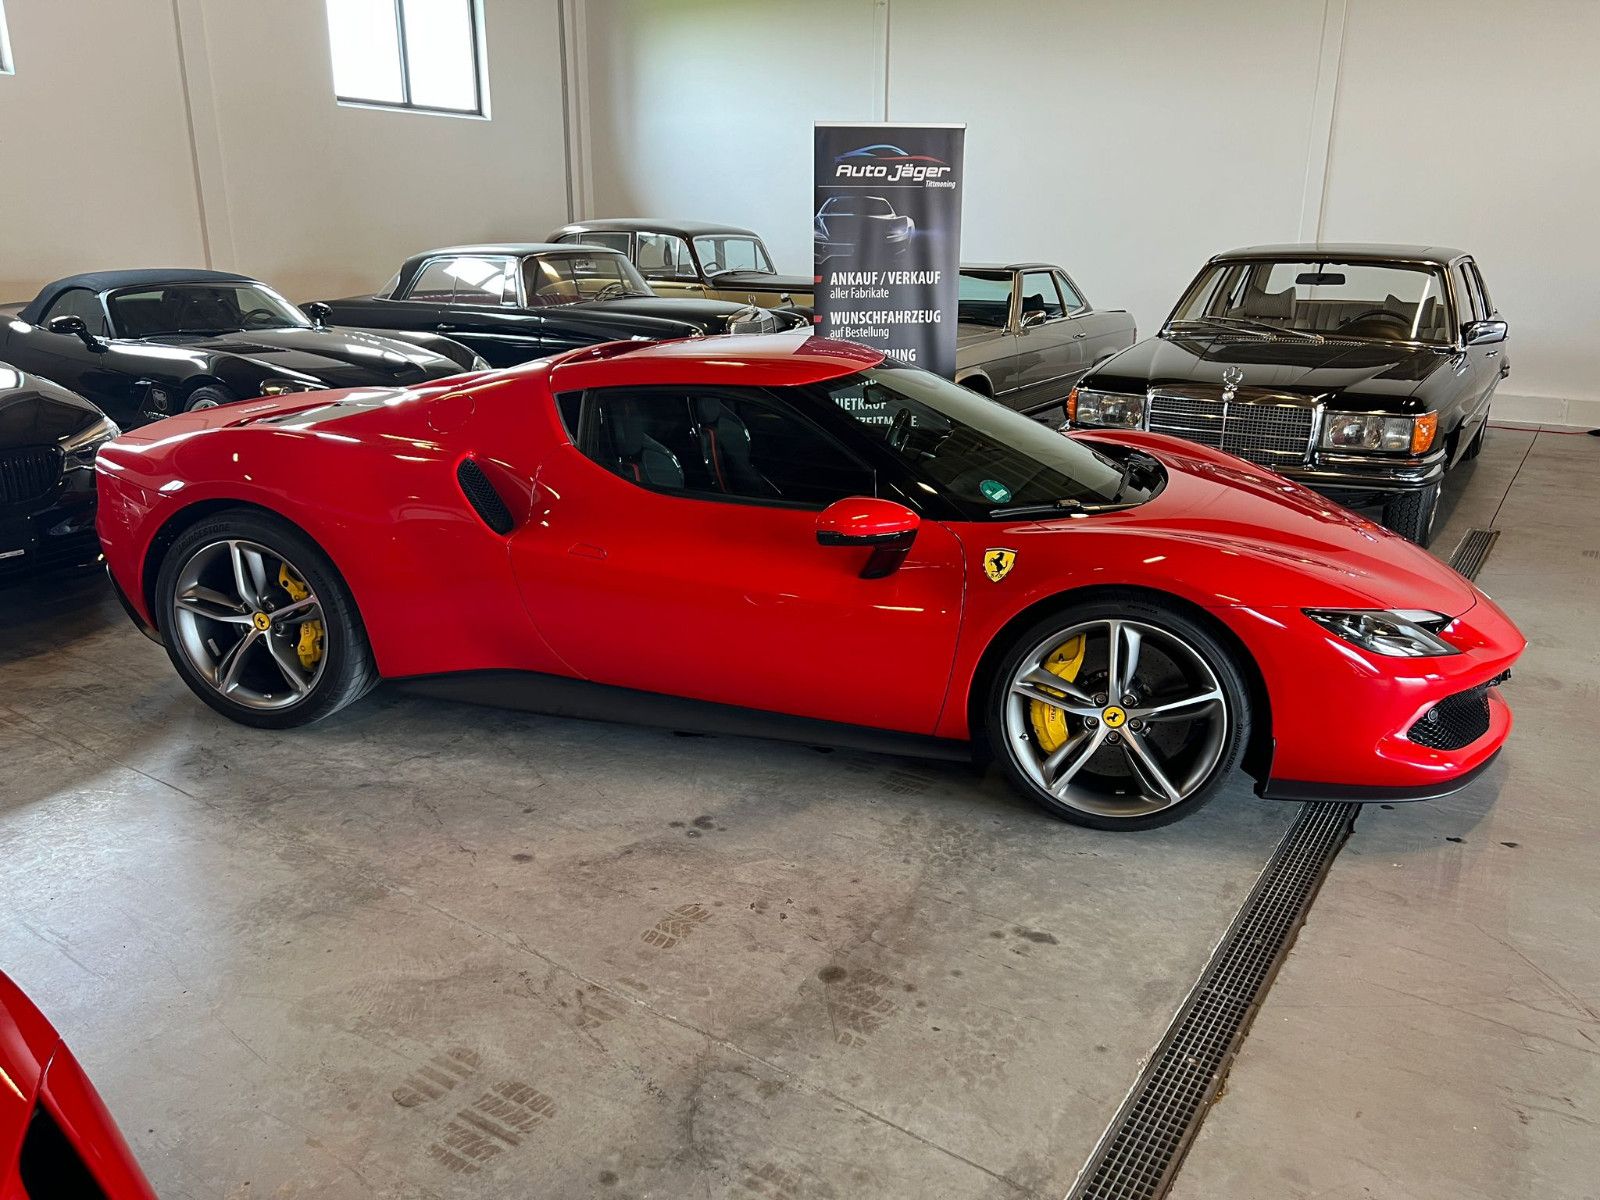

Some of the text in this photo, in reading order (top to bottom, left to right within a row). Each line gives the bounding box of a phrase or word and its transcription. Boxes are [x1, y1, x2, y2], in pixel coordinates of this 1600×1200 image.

[836, 163, 950, 181] Auto Jäger
[925, 180, 956, 189] Tittmoning
[830, 272, 877, 286] ANKAUF
[888, 271, 941, 284] VERKAUF
[830, 287, 890, 299] aller Fabrikate
[830, 310, 941, 325] WUNSCHFAHRZEUG
[830, 326, 890, 339] auf Bestellung
